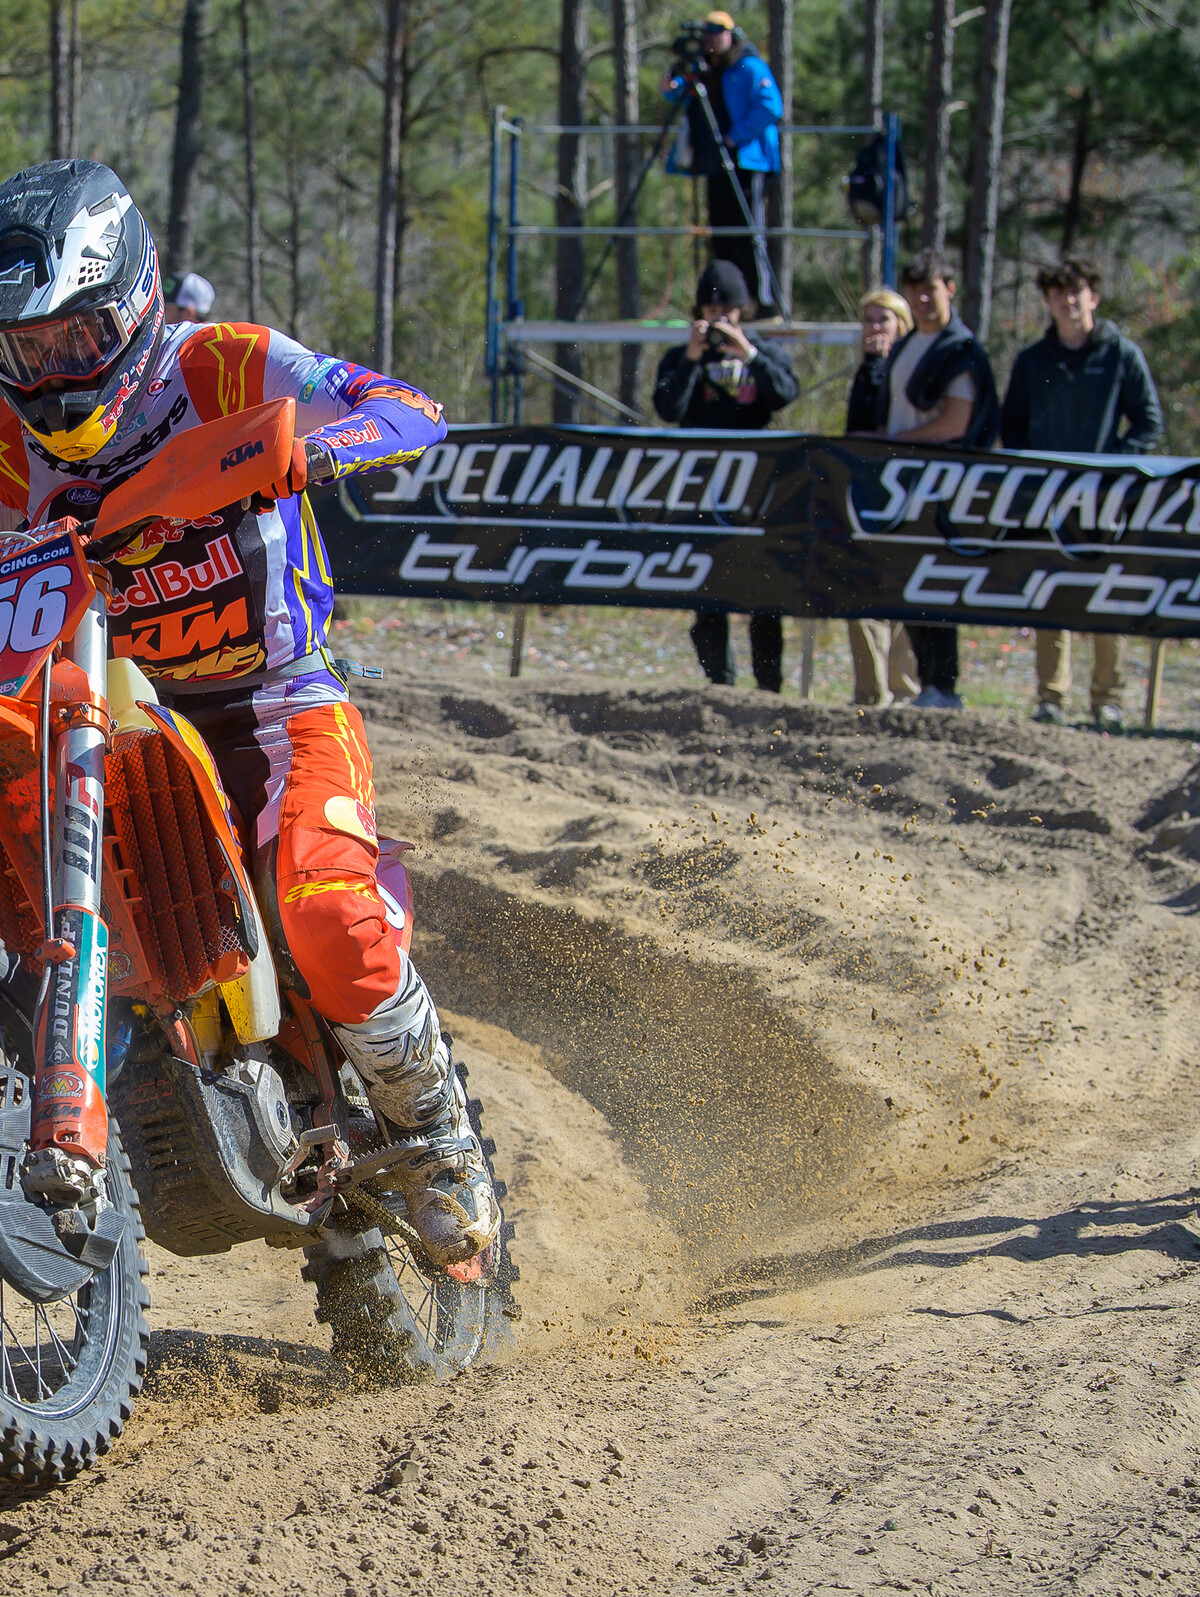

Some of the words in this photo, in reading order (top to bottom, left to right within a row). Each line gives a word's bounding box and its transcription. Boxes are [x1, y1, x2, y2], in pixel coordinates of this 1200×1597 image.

[220, 440, 264, 472] KTM
[333, 445, 427, 480] pinestars
[344, 419, 383, 447] Bull
[106, 568, 161, 617] ed
[150, 533, 244, 602] Bull
[400, 533, 713, 592] turbo
[112, 597, 249, 661] KTM
[52, 921, 77, 1041] DUNLP
